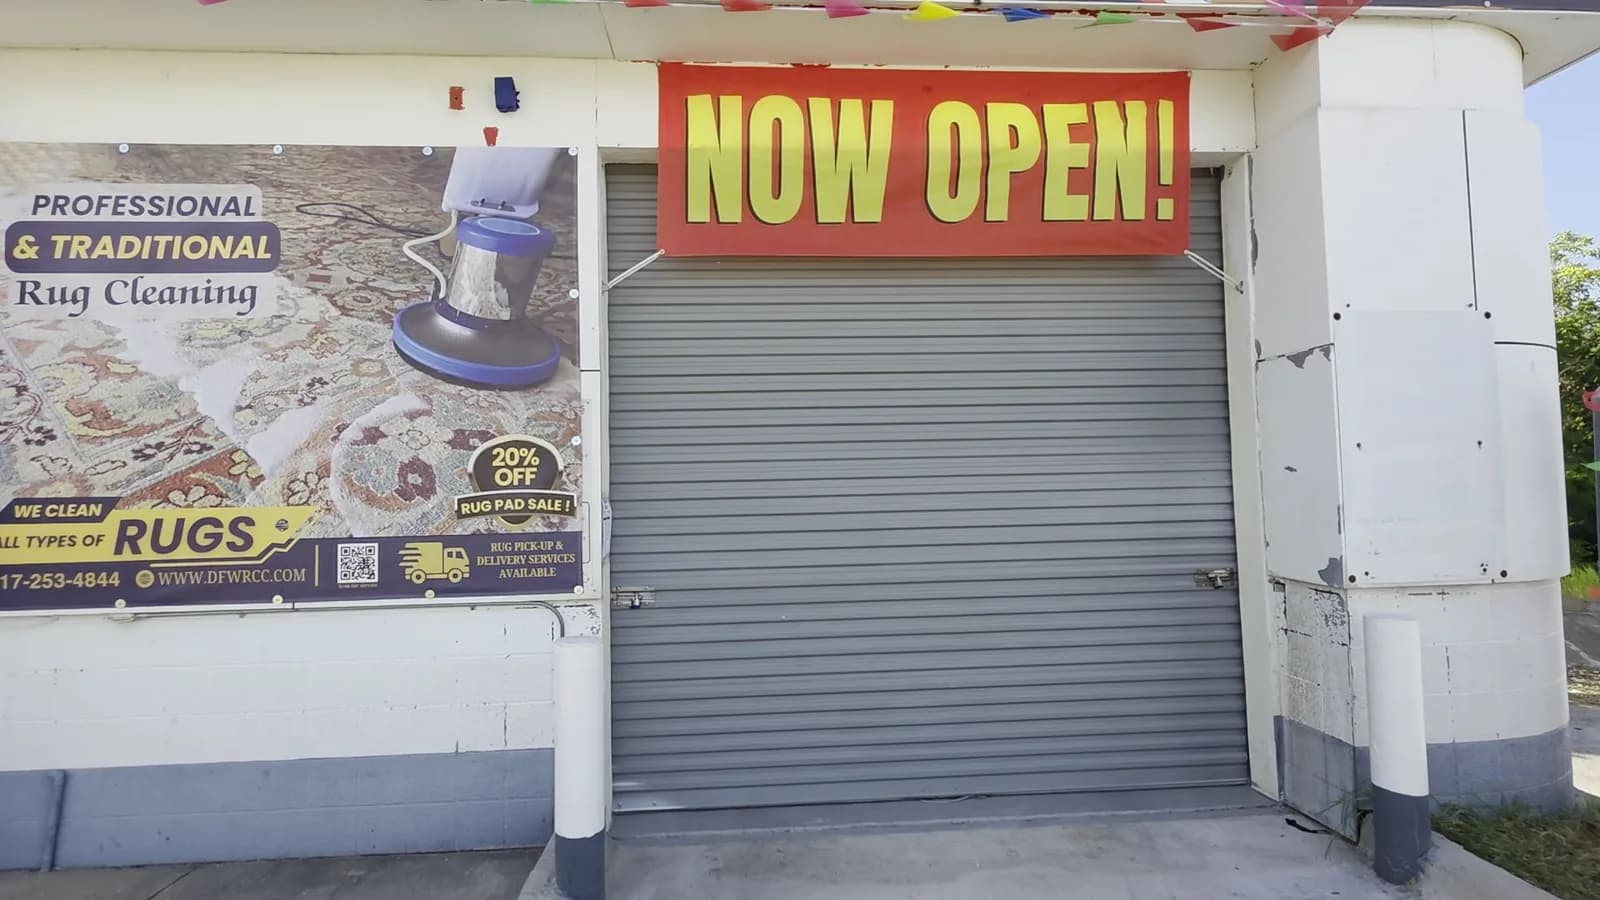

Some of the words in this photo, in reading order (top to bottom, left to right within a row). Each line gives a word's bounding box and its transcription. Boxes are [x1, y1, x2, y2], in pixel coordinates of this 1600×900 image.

[686, 94, 894, 225] NOW
[925, 98, 1175, 223] OPEN!
[32, 195, 256, 217] PROFESSIONAL
[13, 235, 40, 259] &
[50, 235, 272, 259] TRADITIONAL
[15, 277, 90, 317] Rug
[104, 274, 259, 316] Cleaning
[492, 447, 540, 466] 20%
[494, 468, 538, 487] OFF
[13, 503, 42, 519] WE
[44, 502, 103, 518] CLEAN
[460, 501, 491, 515] RUG
[494, 498, 524, 512] PAD
[528, 498, 562, 511] SALE
[0, 536, 20, 549] LL
[26, 534, 79, 548] TYPES
[82, 533, 105, 548] OF
[113, 516, 256, 556] RUGS
[490, 542, 512, 552] RUG
[514, 541, 554, 551] PICK-UP
[555, 541, 564, 550] &
[476, 555, 526, 566] DELIVERY
[528, 553, 576, 565] SERVICES
[158, 568, 306, 585] WWW.DFWRCC.COM
[499, 567, 557, 579] AVAILABLE
